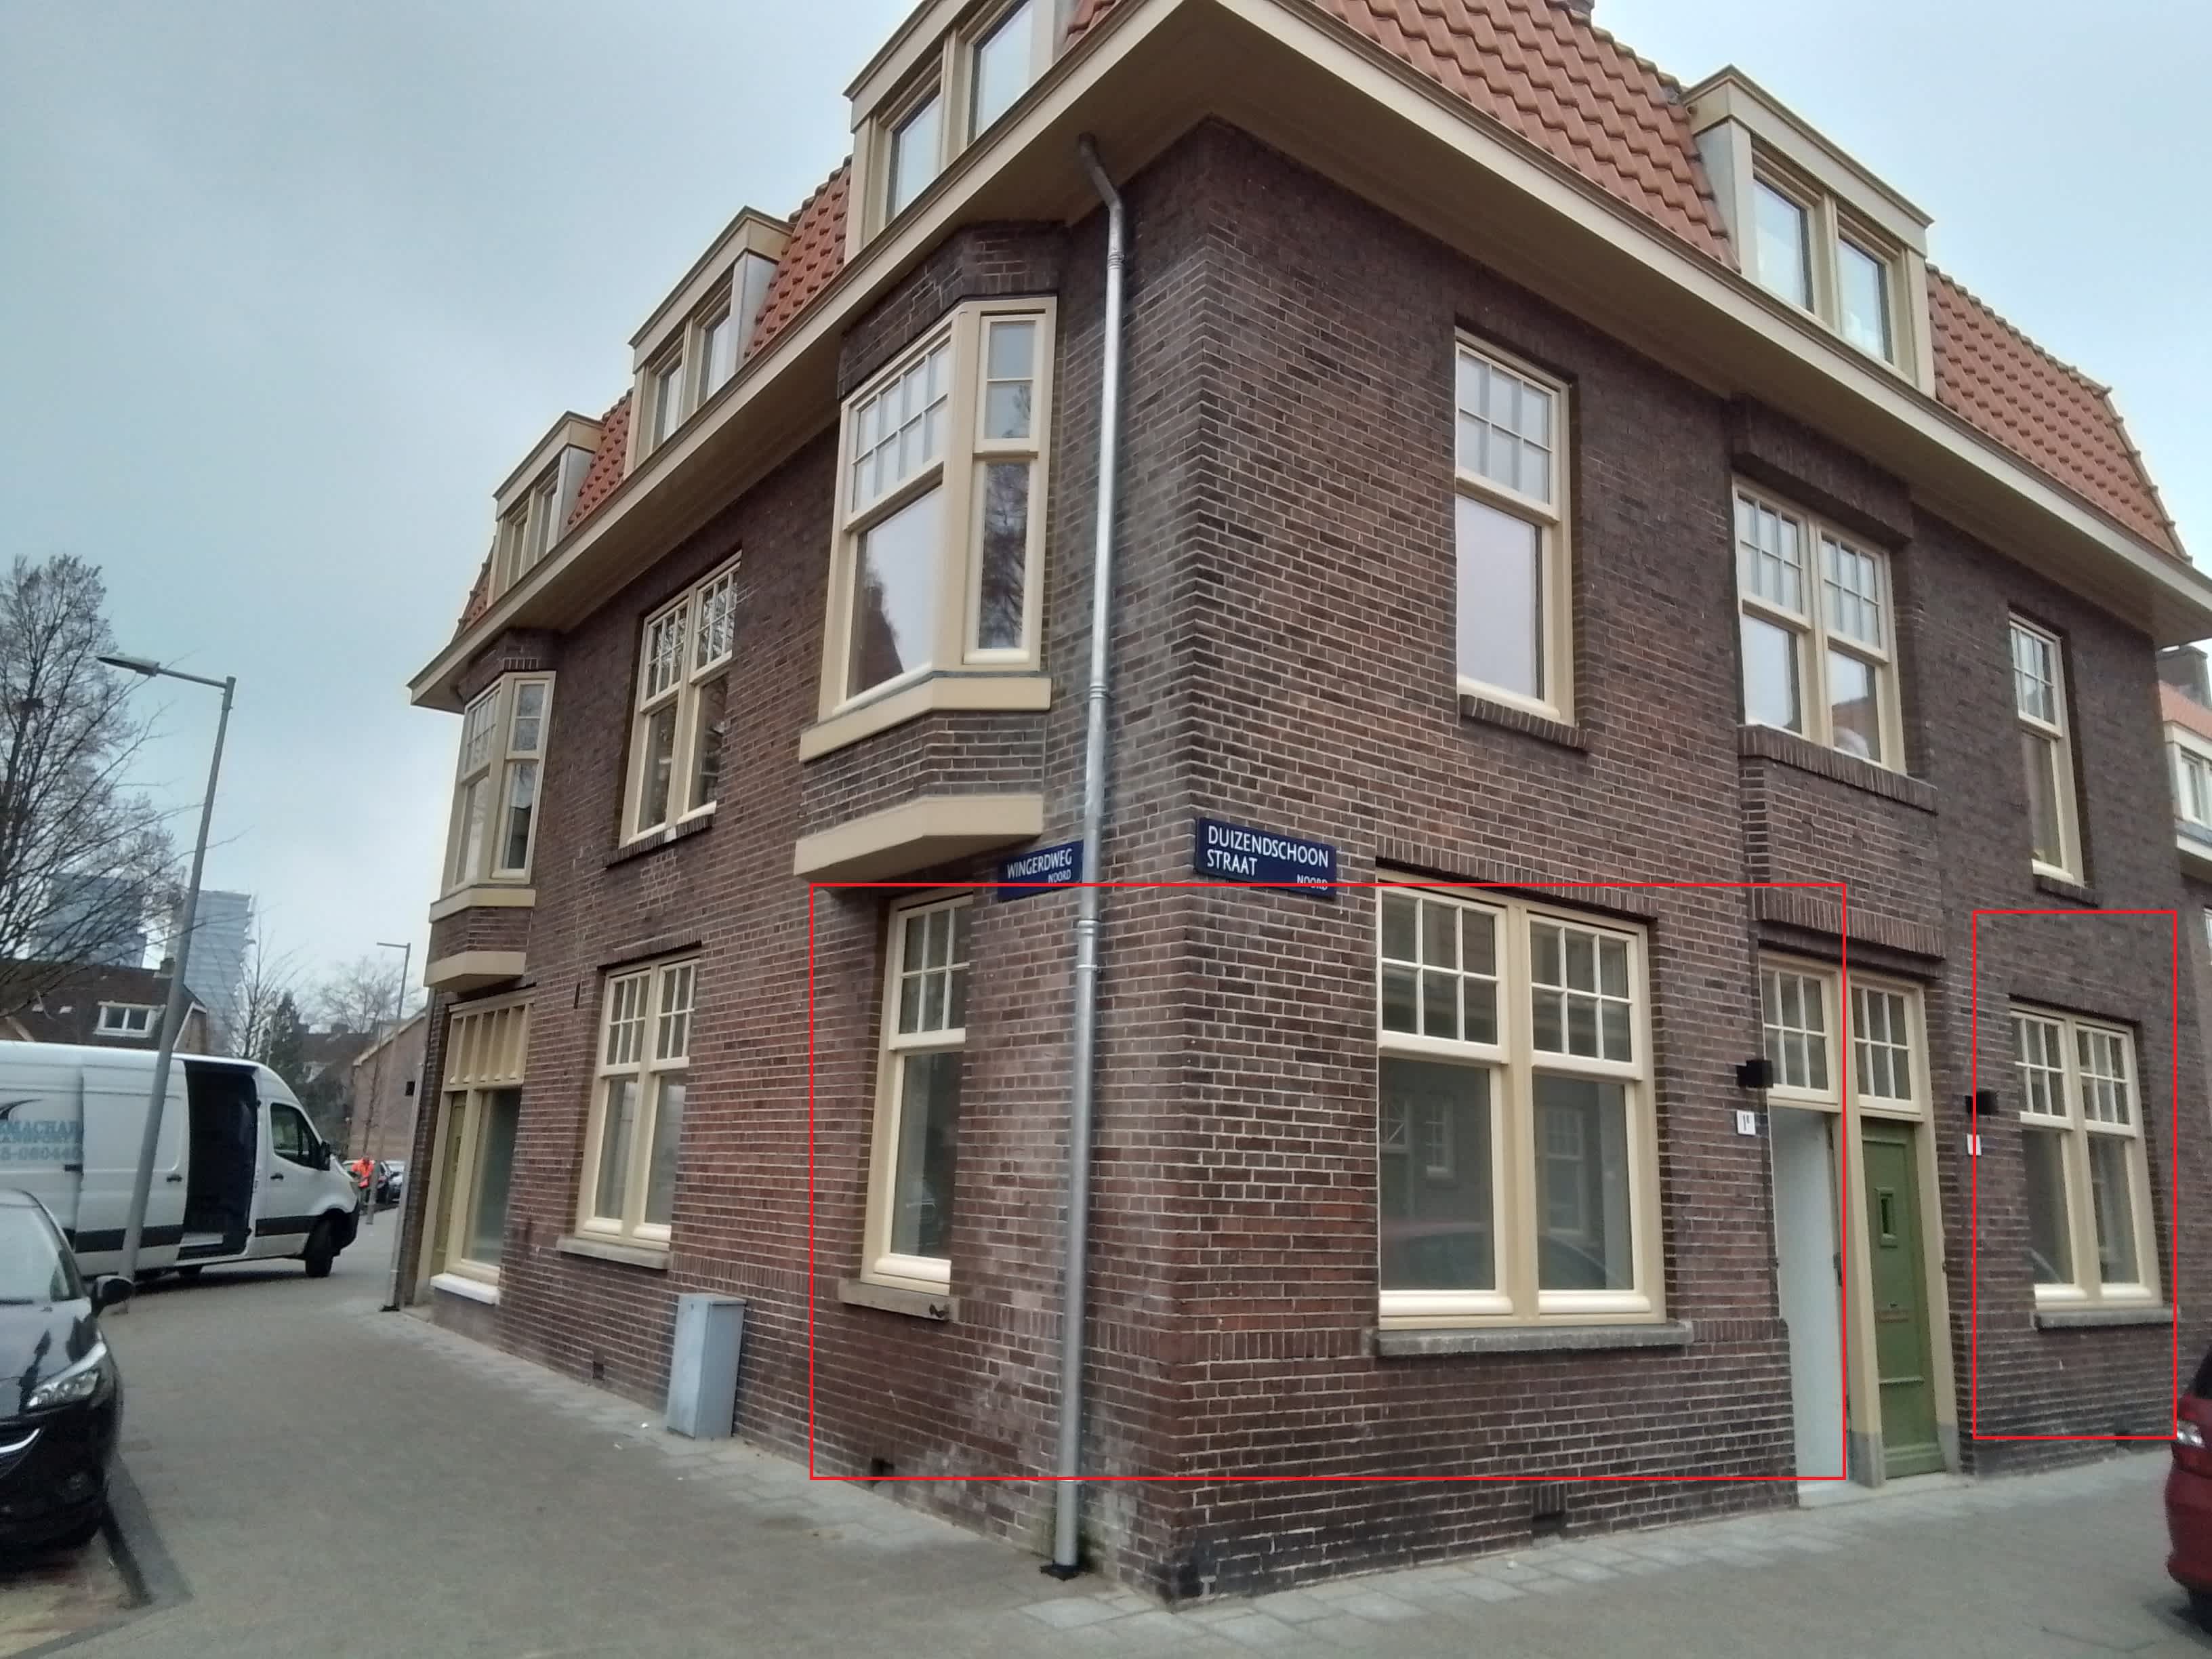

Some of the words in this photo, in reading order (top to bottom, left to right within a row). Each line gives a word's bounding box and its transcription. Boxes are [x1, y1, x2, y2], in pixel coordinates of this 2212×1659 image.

[1208, 825, 1328, 868] DUIZENDSCHOON
[1007, 848, 1072, 879] WINGERDWEG
[1048, 869, 1071, 883] NOORD
[1207, 849, 1258, 876] STRAAT
[1296, 874, 1328, 890] NOORD
